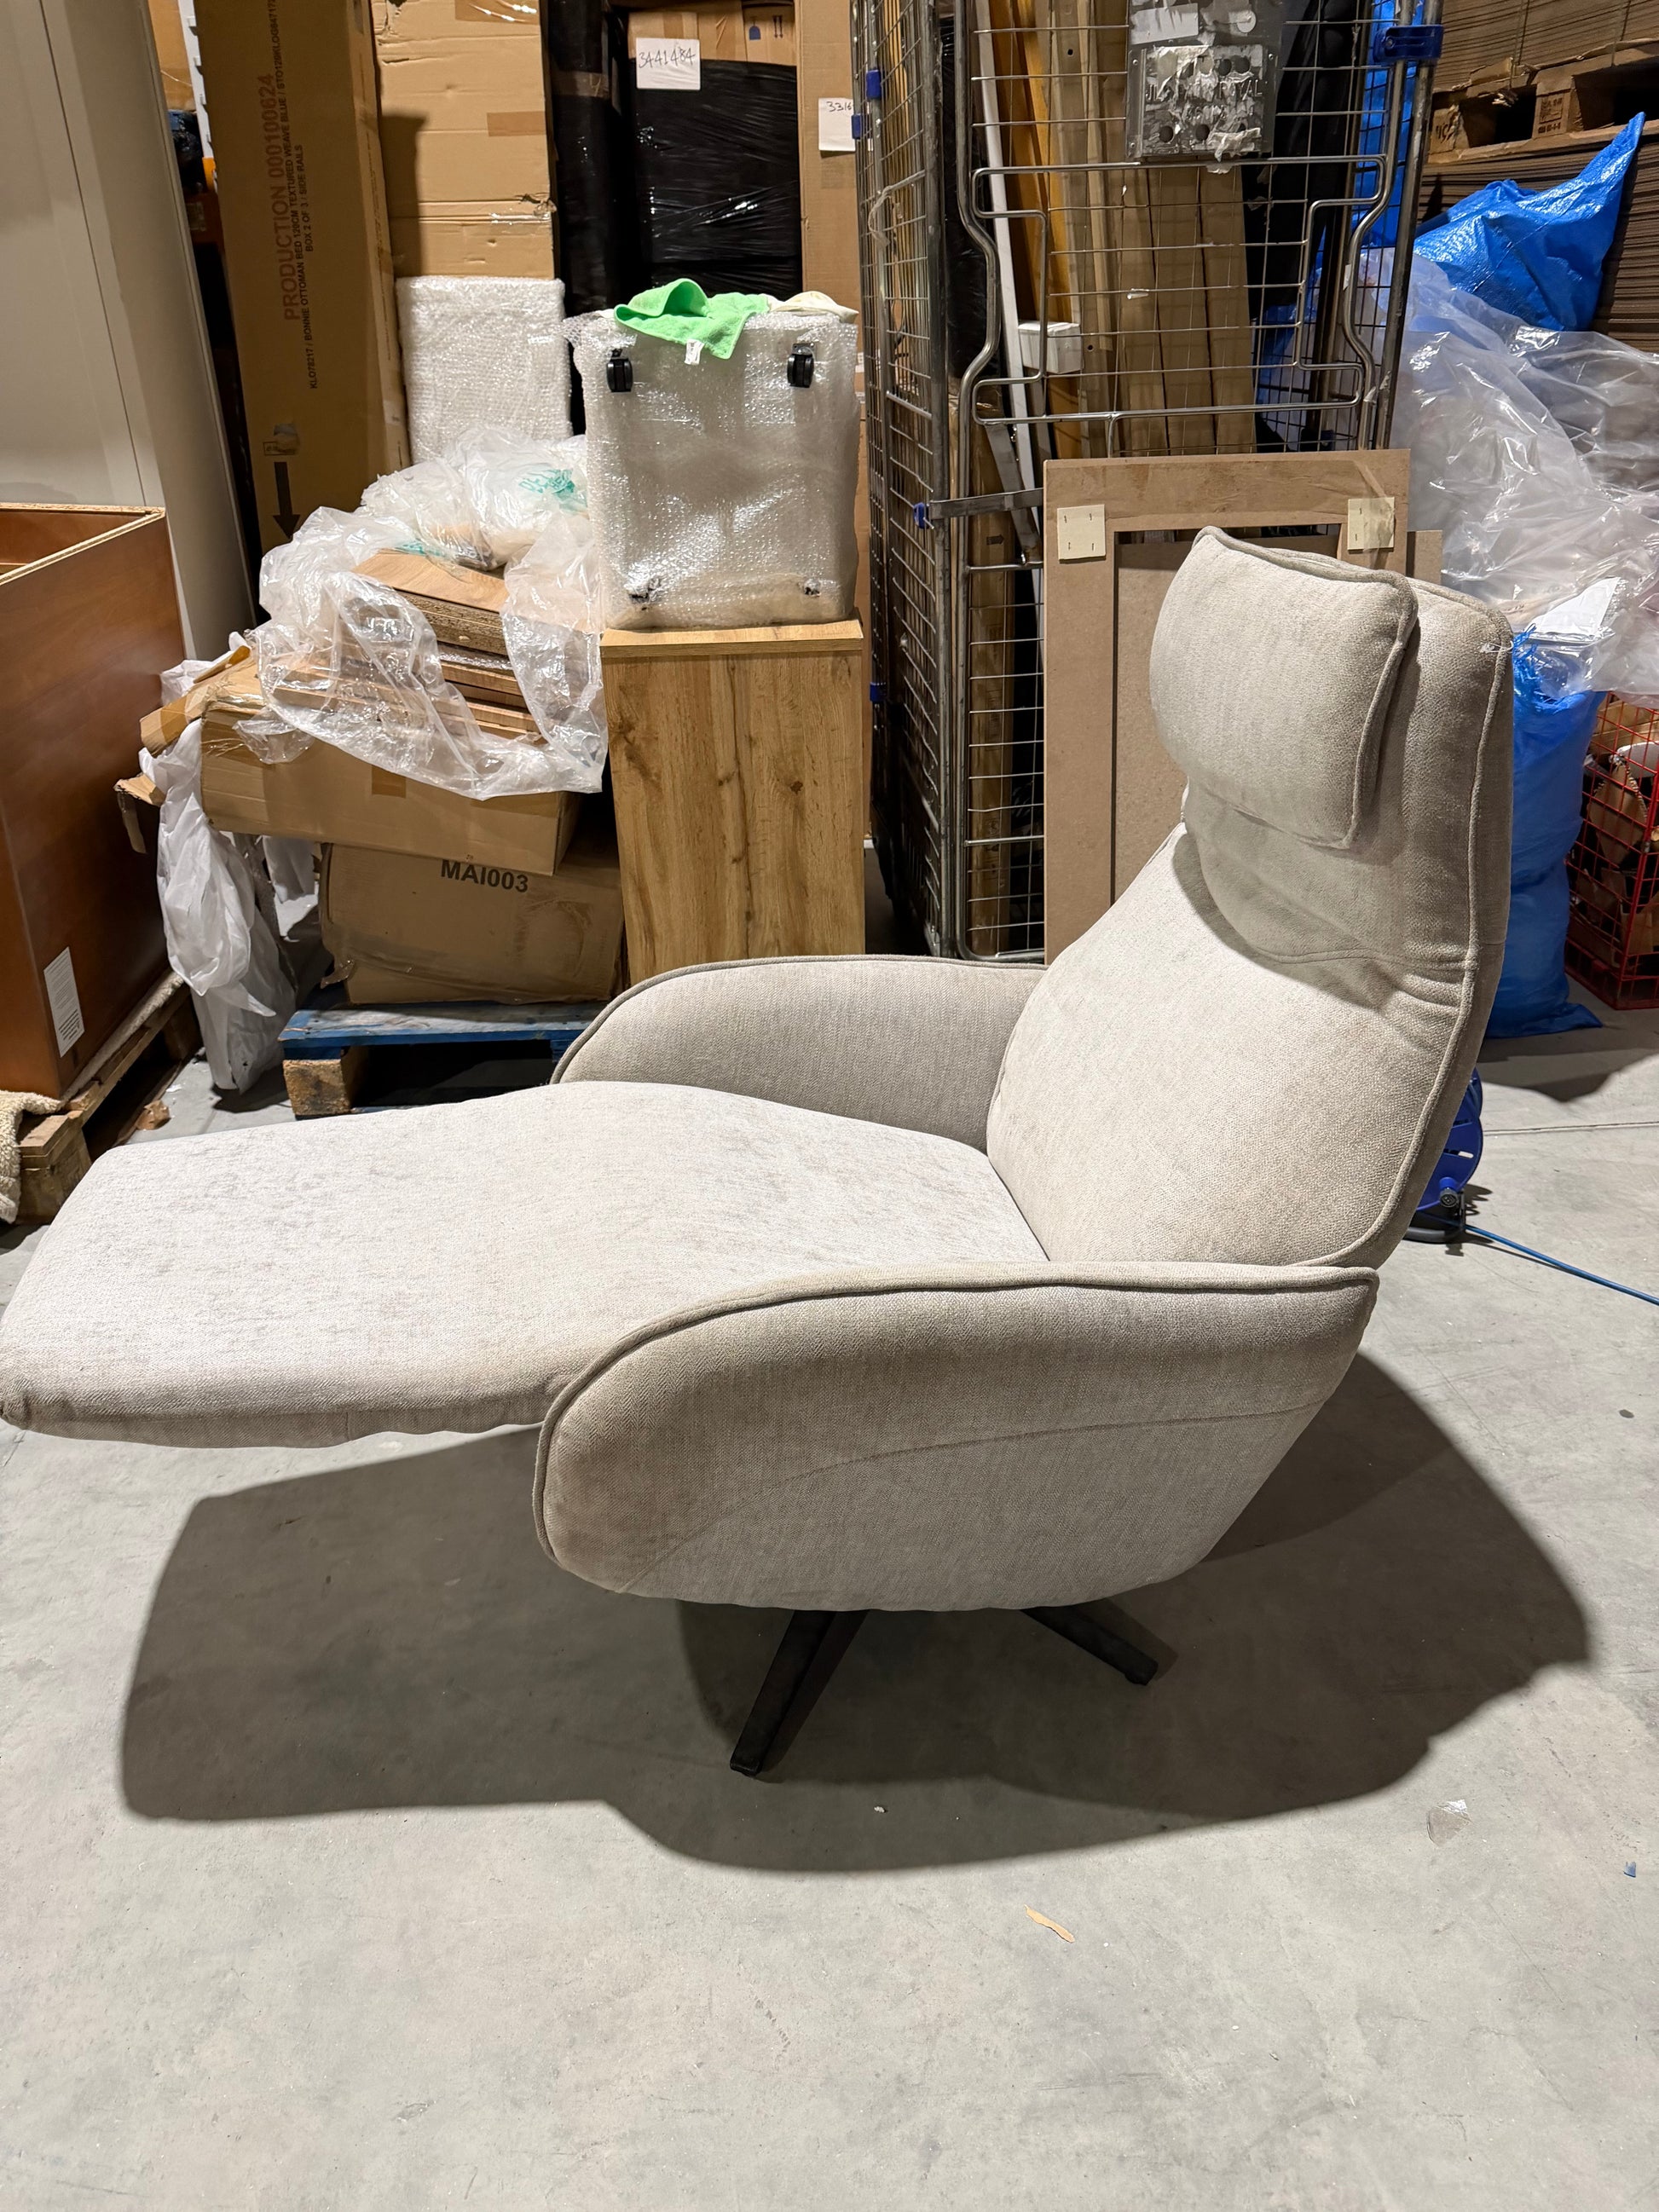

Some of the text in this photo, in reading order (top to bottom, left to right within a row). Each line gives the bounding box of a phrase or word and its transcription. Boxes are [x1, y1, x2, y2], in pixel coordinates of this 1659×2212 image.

[638, 47, 697, 69] 3441484
[279, 98, 289, 122] BLUE
[281, 124, 292, 157] WEAVE
[295, 145, 304, 171] RAILS
[285, 159, 298, 206] TEXTURED
[297, 174, 308, 195] SIDE
[257, 73, 301, 320] PRODUCTION 000100624
[291, 211, 301, 238] 120CM
[301, 210, 310, 222] OF
[293, 241, 303, 259] BED
[304, 233, 314, 251] BOX
[298, 262, 309, 305] OTTOMAN
[302, 307, 312, 341] BONNIE
[441, 858, 529, 893] MAI003
